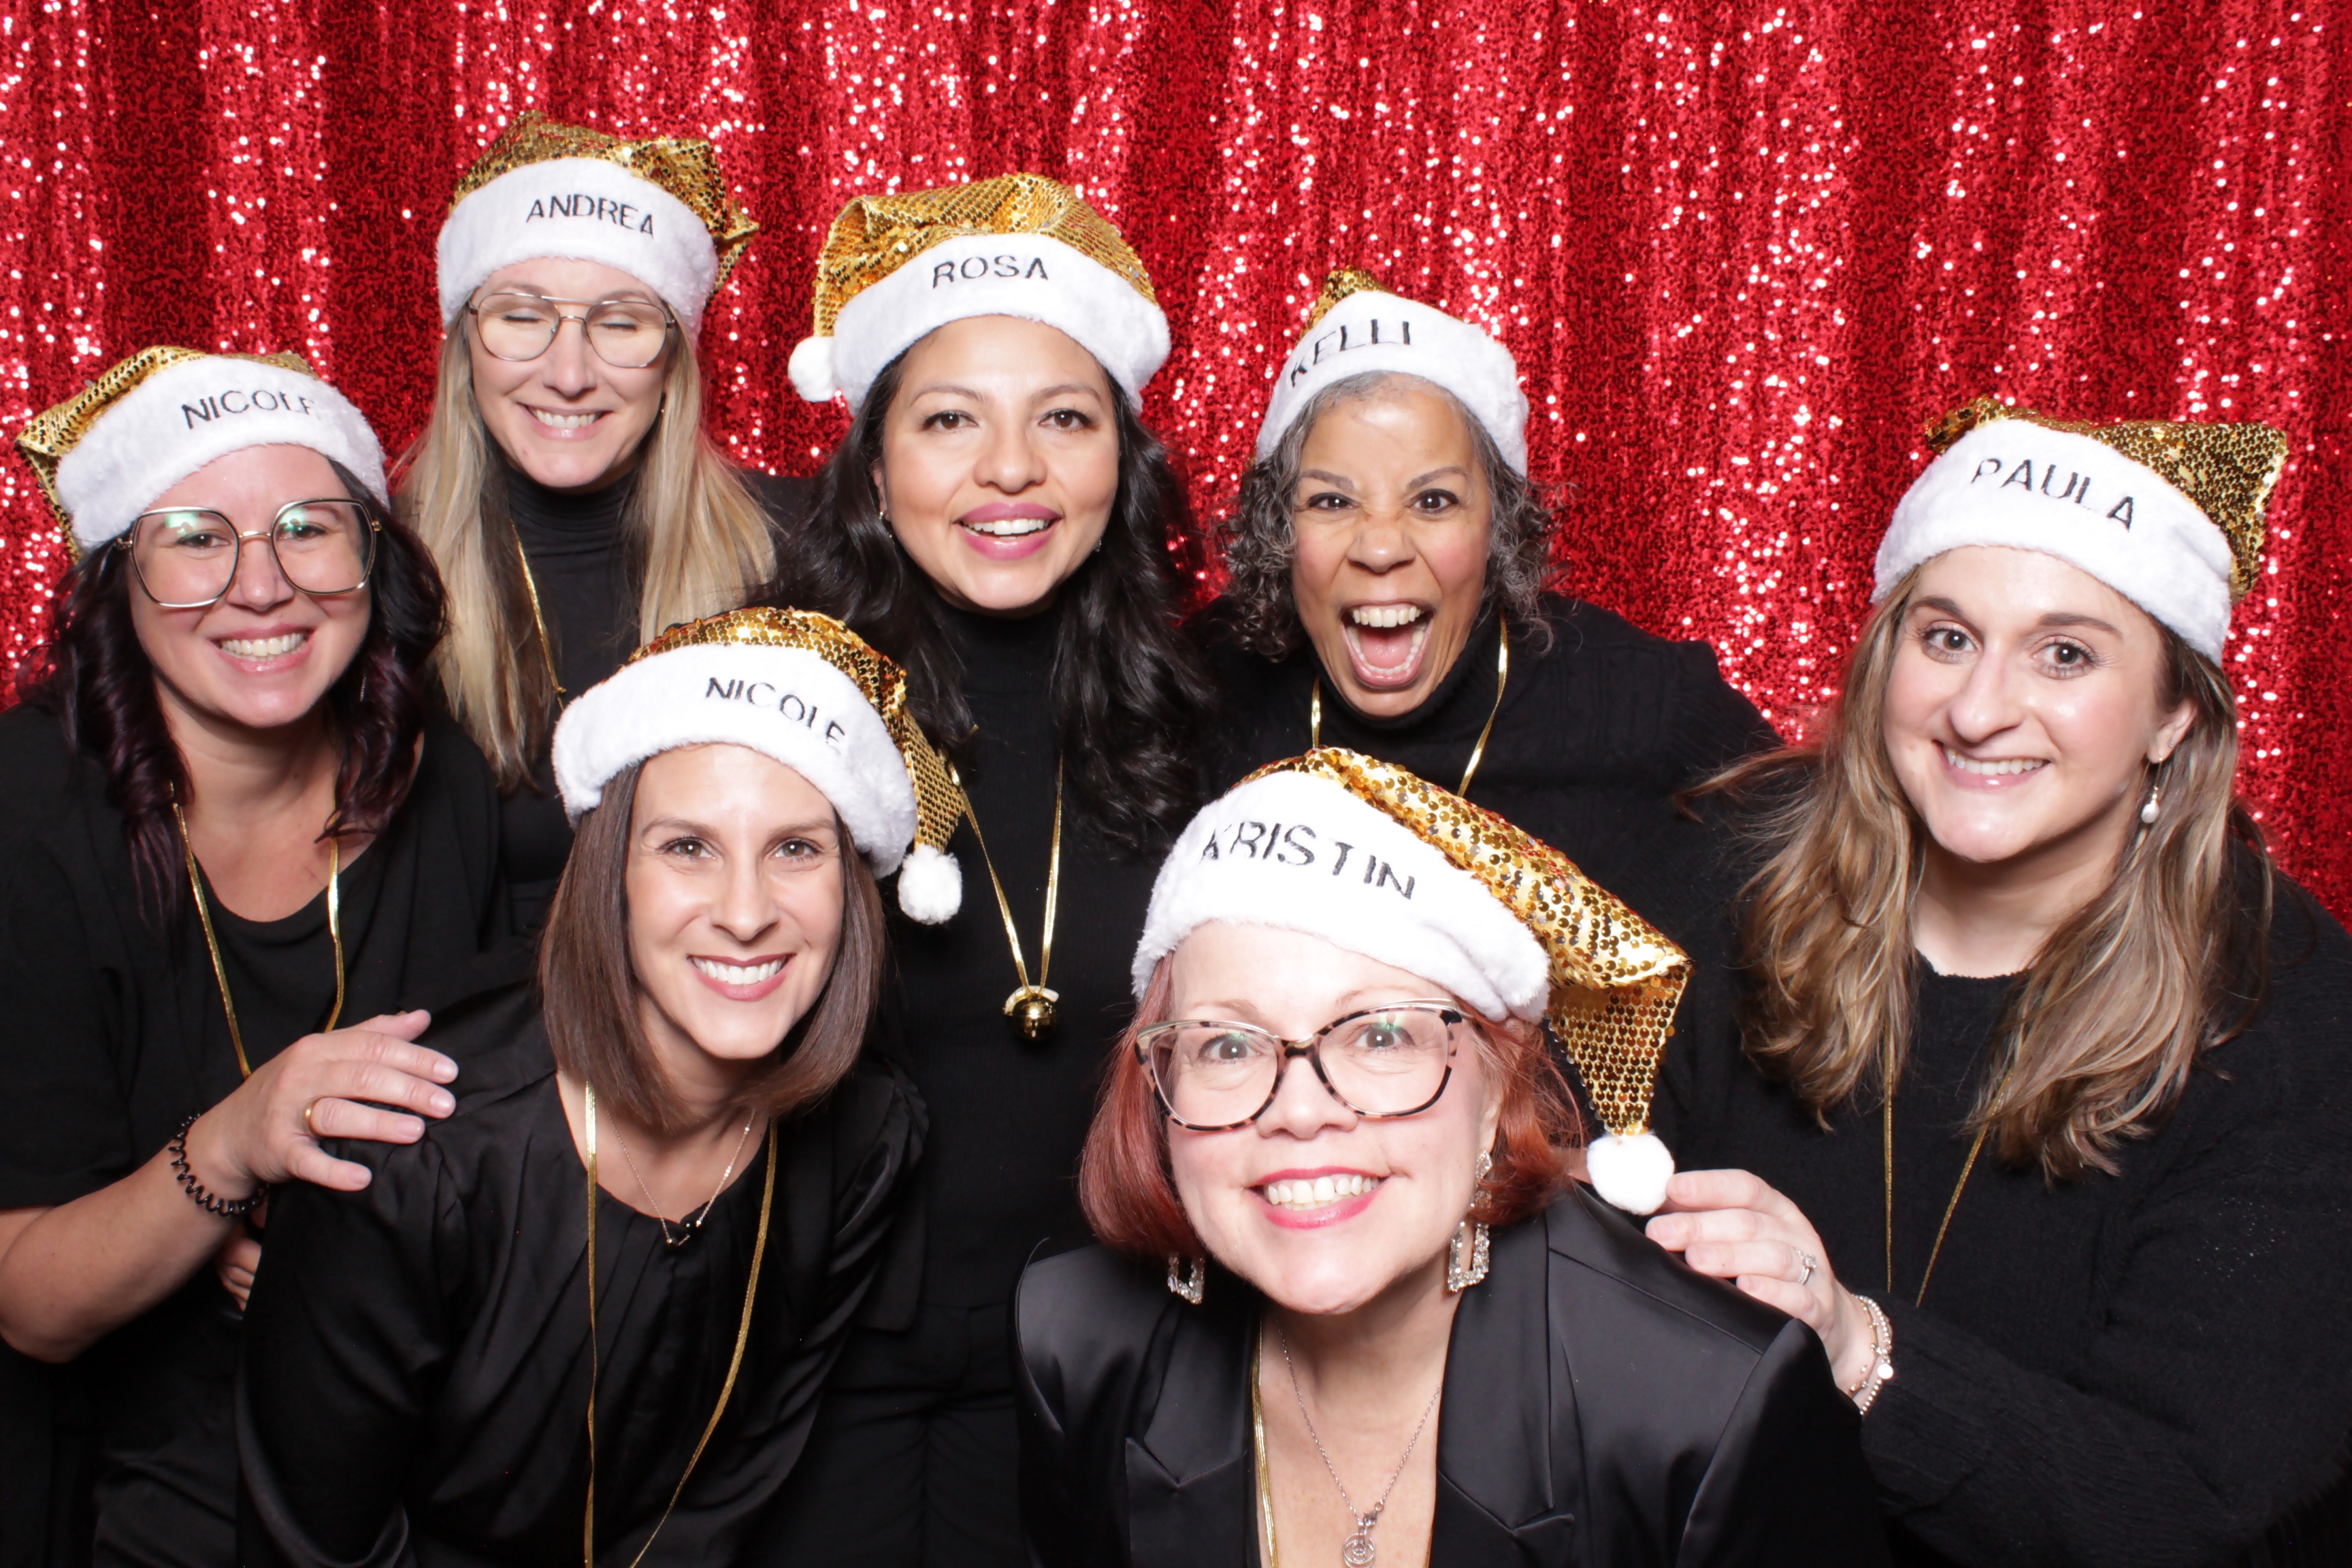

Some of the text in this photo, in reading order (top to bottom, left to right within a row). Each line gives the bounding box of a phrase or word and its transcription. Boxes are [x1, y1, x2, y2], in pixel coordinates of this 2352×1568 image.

[525, 193, 654, 239] ANDREA
[932, 255, 1049, 289] ROSA
[1290, 318, 1411, 388] KELLI
[181, 389, 320, 430] NICOLE
[1970, 458, 2134, 533] PAULA
[705, 676, 846, 755] NICOLE
[1199, 821, 1416, 900] KRISTIN
